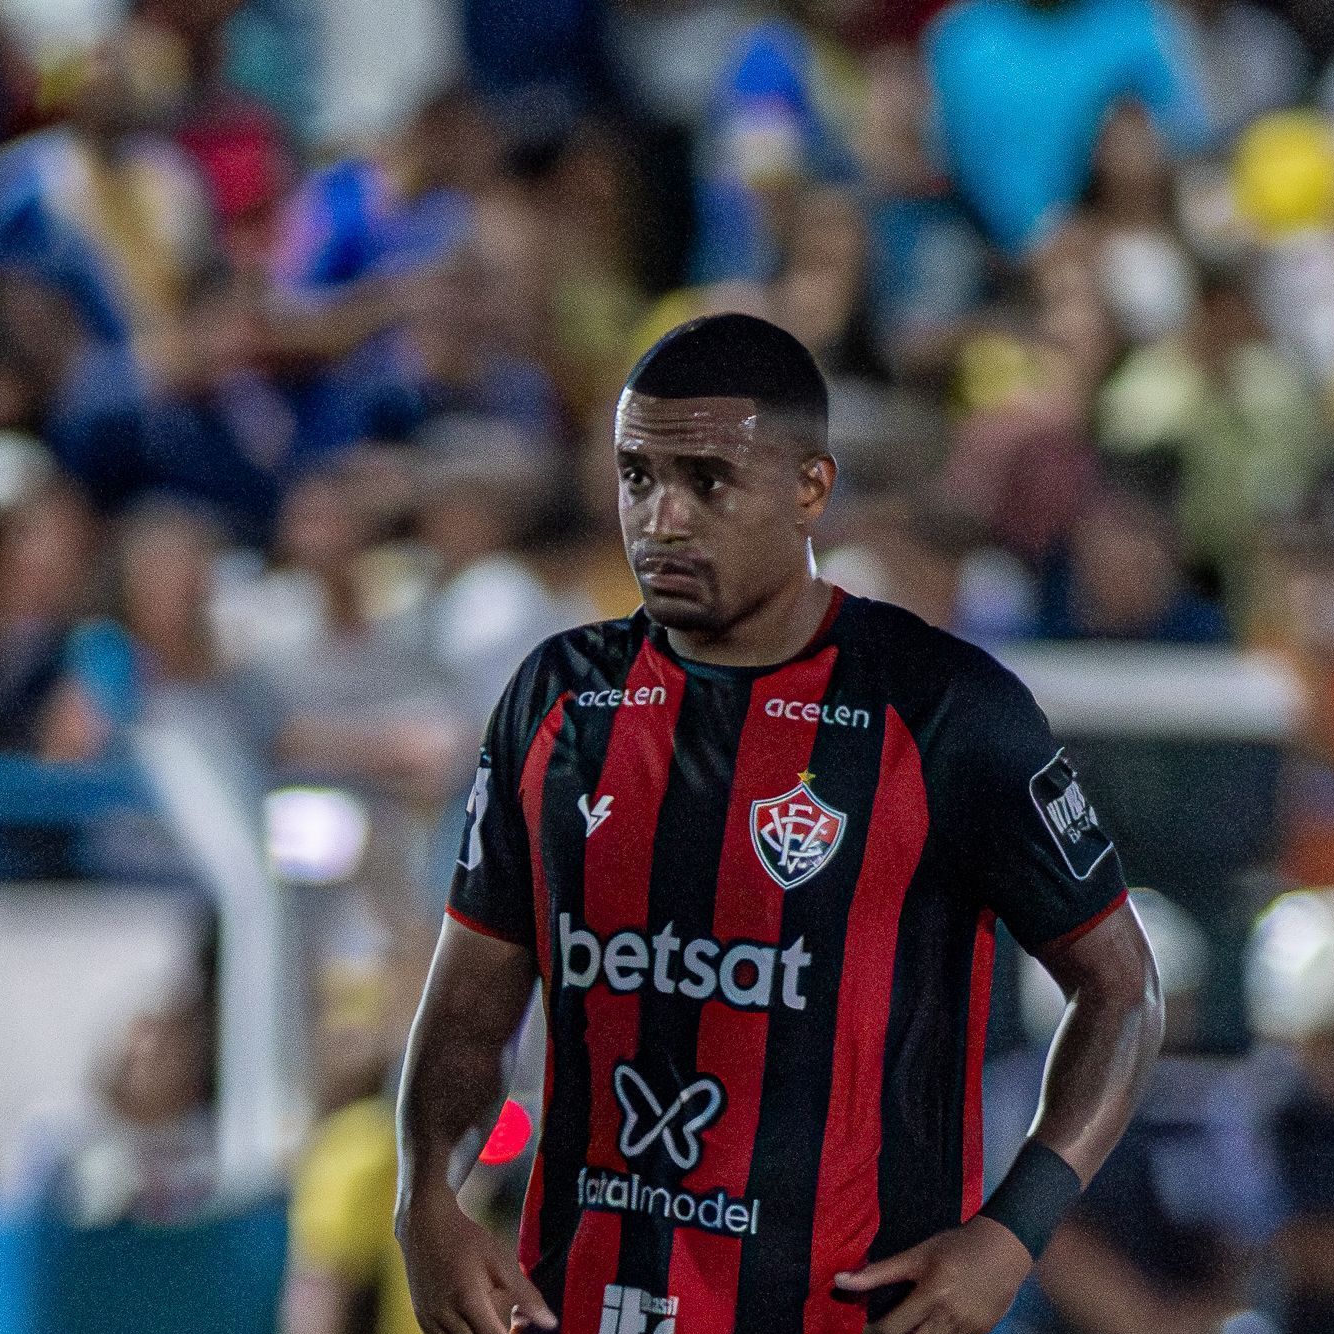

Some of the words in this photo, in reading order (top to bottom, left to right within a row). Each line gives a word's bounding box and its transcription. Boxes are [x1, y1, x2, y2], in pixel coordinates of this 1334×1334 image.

[577, 686, 666, 707] acelen
[764, 698, 870, 728] acelen
[559, 911, 812, 1011] betsat
